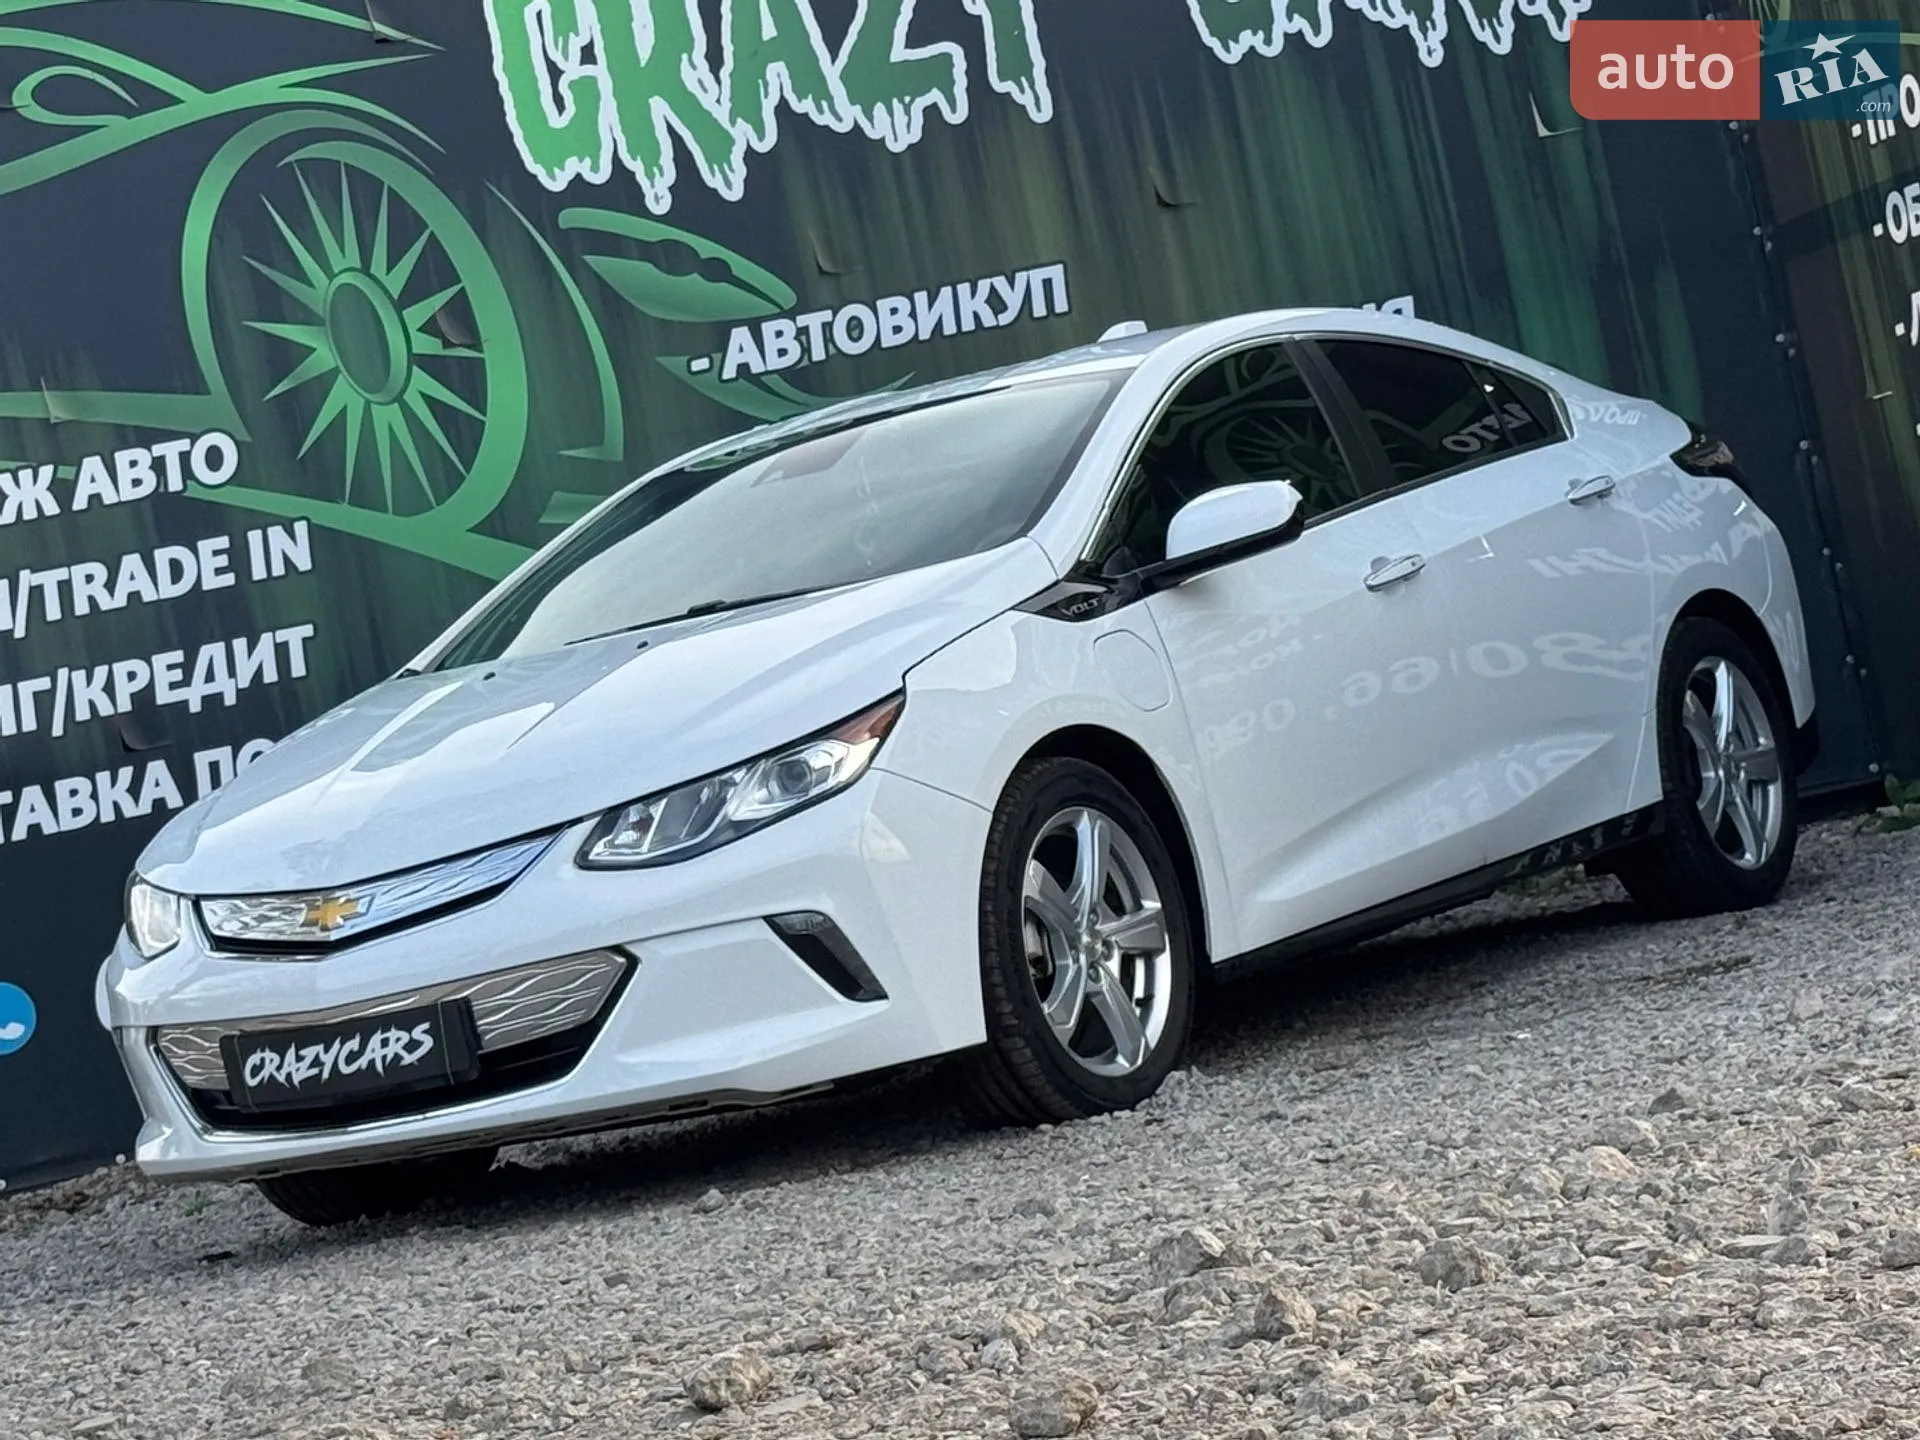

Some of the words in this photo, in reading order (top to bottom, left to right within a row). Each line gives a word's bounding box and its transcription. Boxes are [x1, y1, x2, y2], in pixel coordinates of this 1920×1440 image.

[721, 263, 1070, 381] АВТОВИКУП
[72, 431, 238, 511] АВТО
[0, 535, 236, 638] /TRADE
[247, 520, 313, 582] IN
[1062, 597, 1101, 617] VOLT
